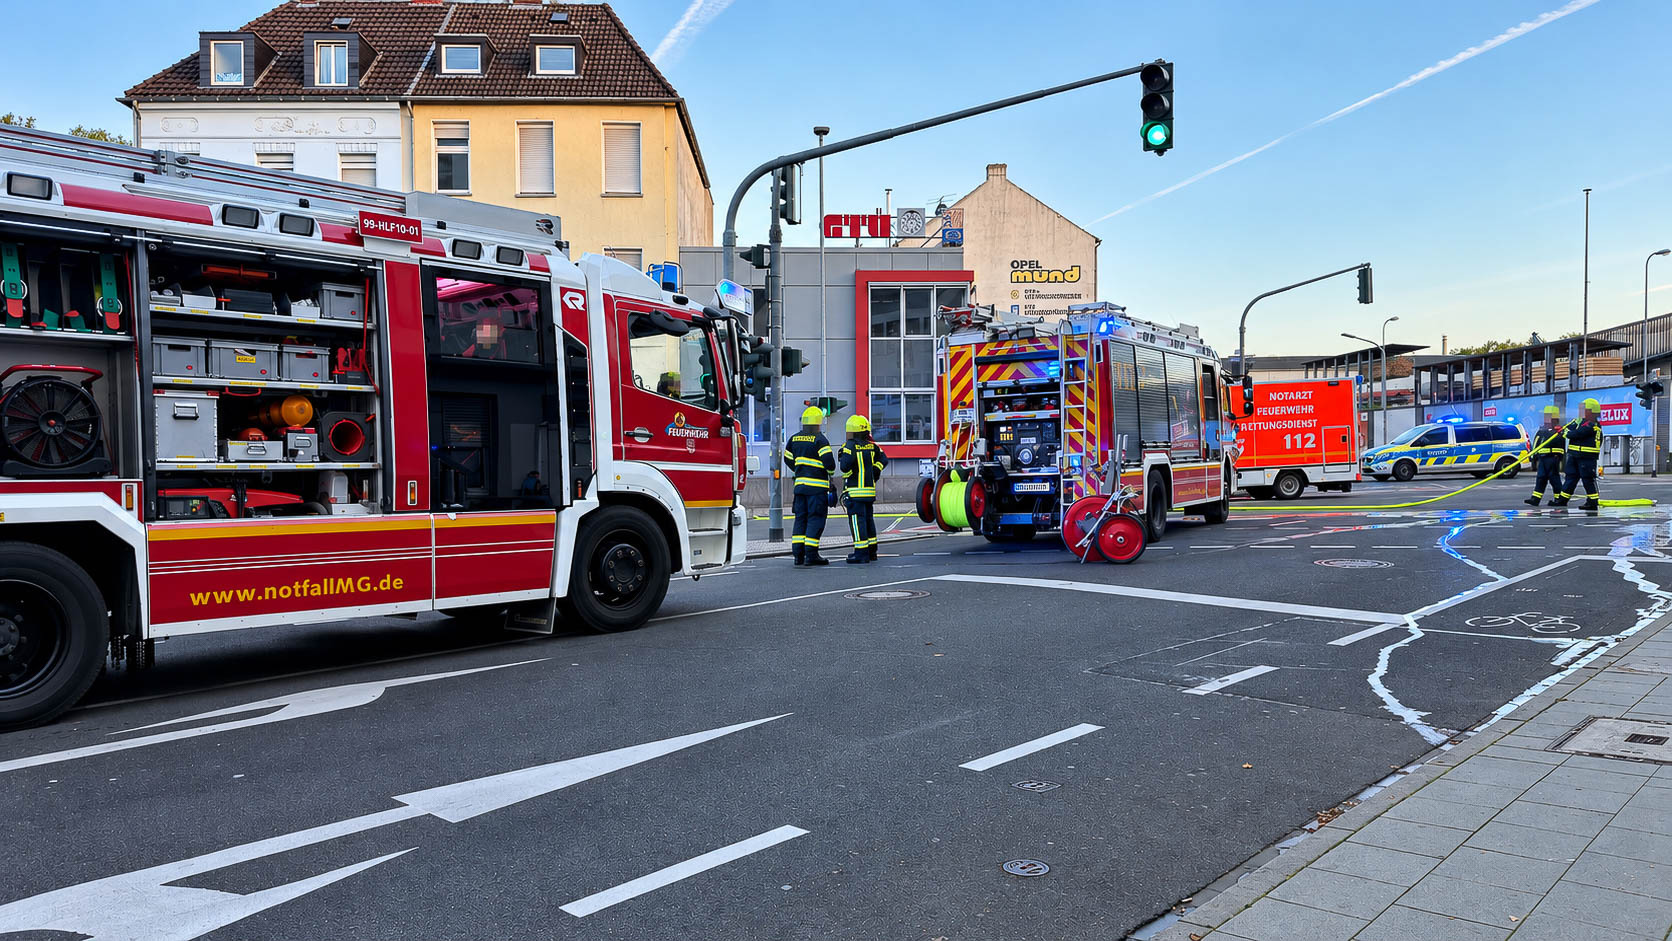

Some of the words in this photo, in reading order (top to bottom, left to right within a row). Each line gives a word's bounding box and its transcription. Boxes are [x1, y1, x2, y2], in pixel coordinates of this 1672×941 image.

[363, 218, 419, 236] 99-HLF10-01
[1010, 259, 1042, 269] OPEL
[1010, 265, 1081, 283] mund
[1269, 390, 1313, 401] NOTARZT
[1256, 404, 1314, 416] FEUERWEHR
[1599, 407, 1630, 422] ELUX
[1283, 432, 1316, 449] 112
[189, 573, 404, 606] www.notfallMG.de
